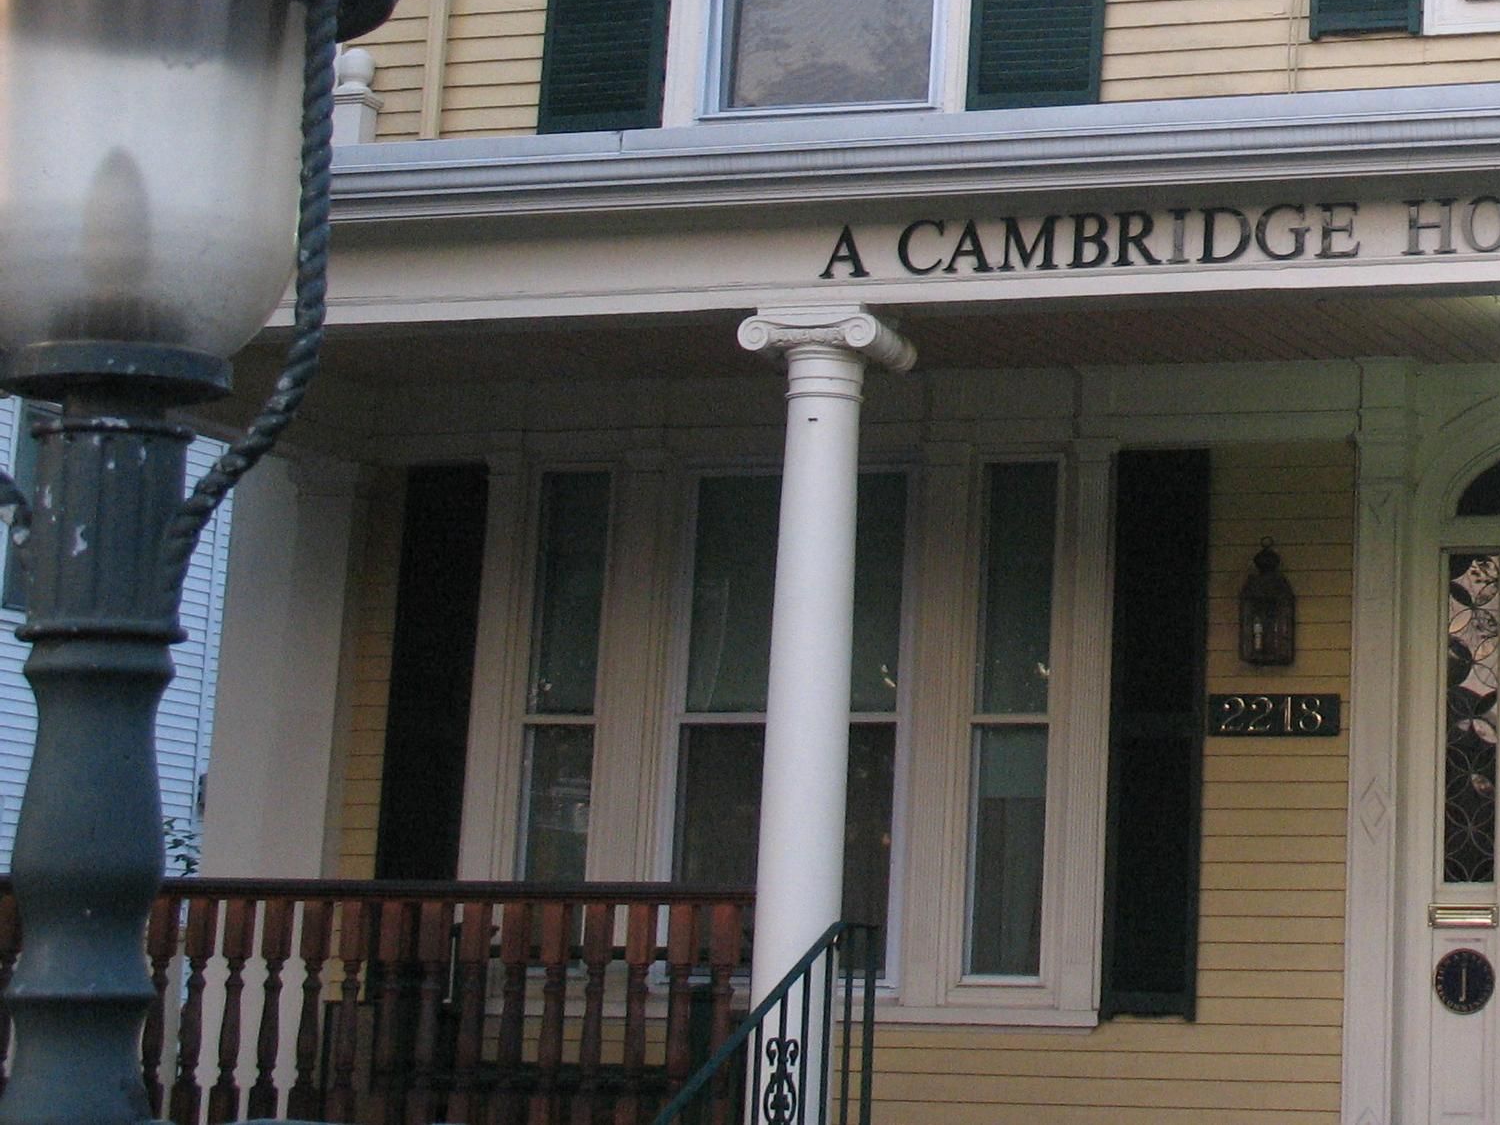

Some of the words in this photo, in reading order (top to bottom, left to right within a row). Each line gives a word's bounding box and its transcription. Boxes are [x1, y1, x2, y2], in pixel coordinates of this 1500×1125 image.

[819, 224, 870, 279] A
[897, 202, 1361, 276] CAMBRIDGE
[1220, 696, 1322, 732] 2218
